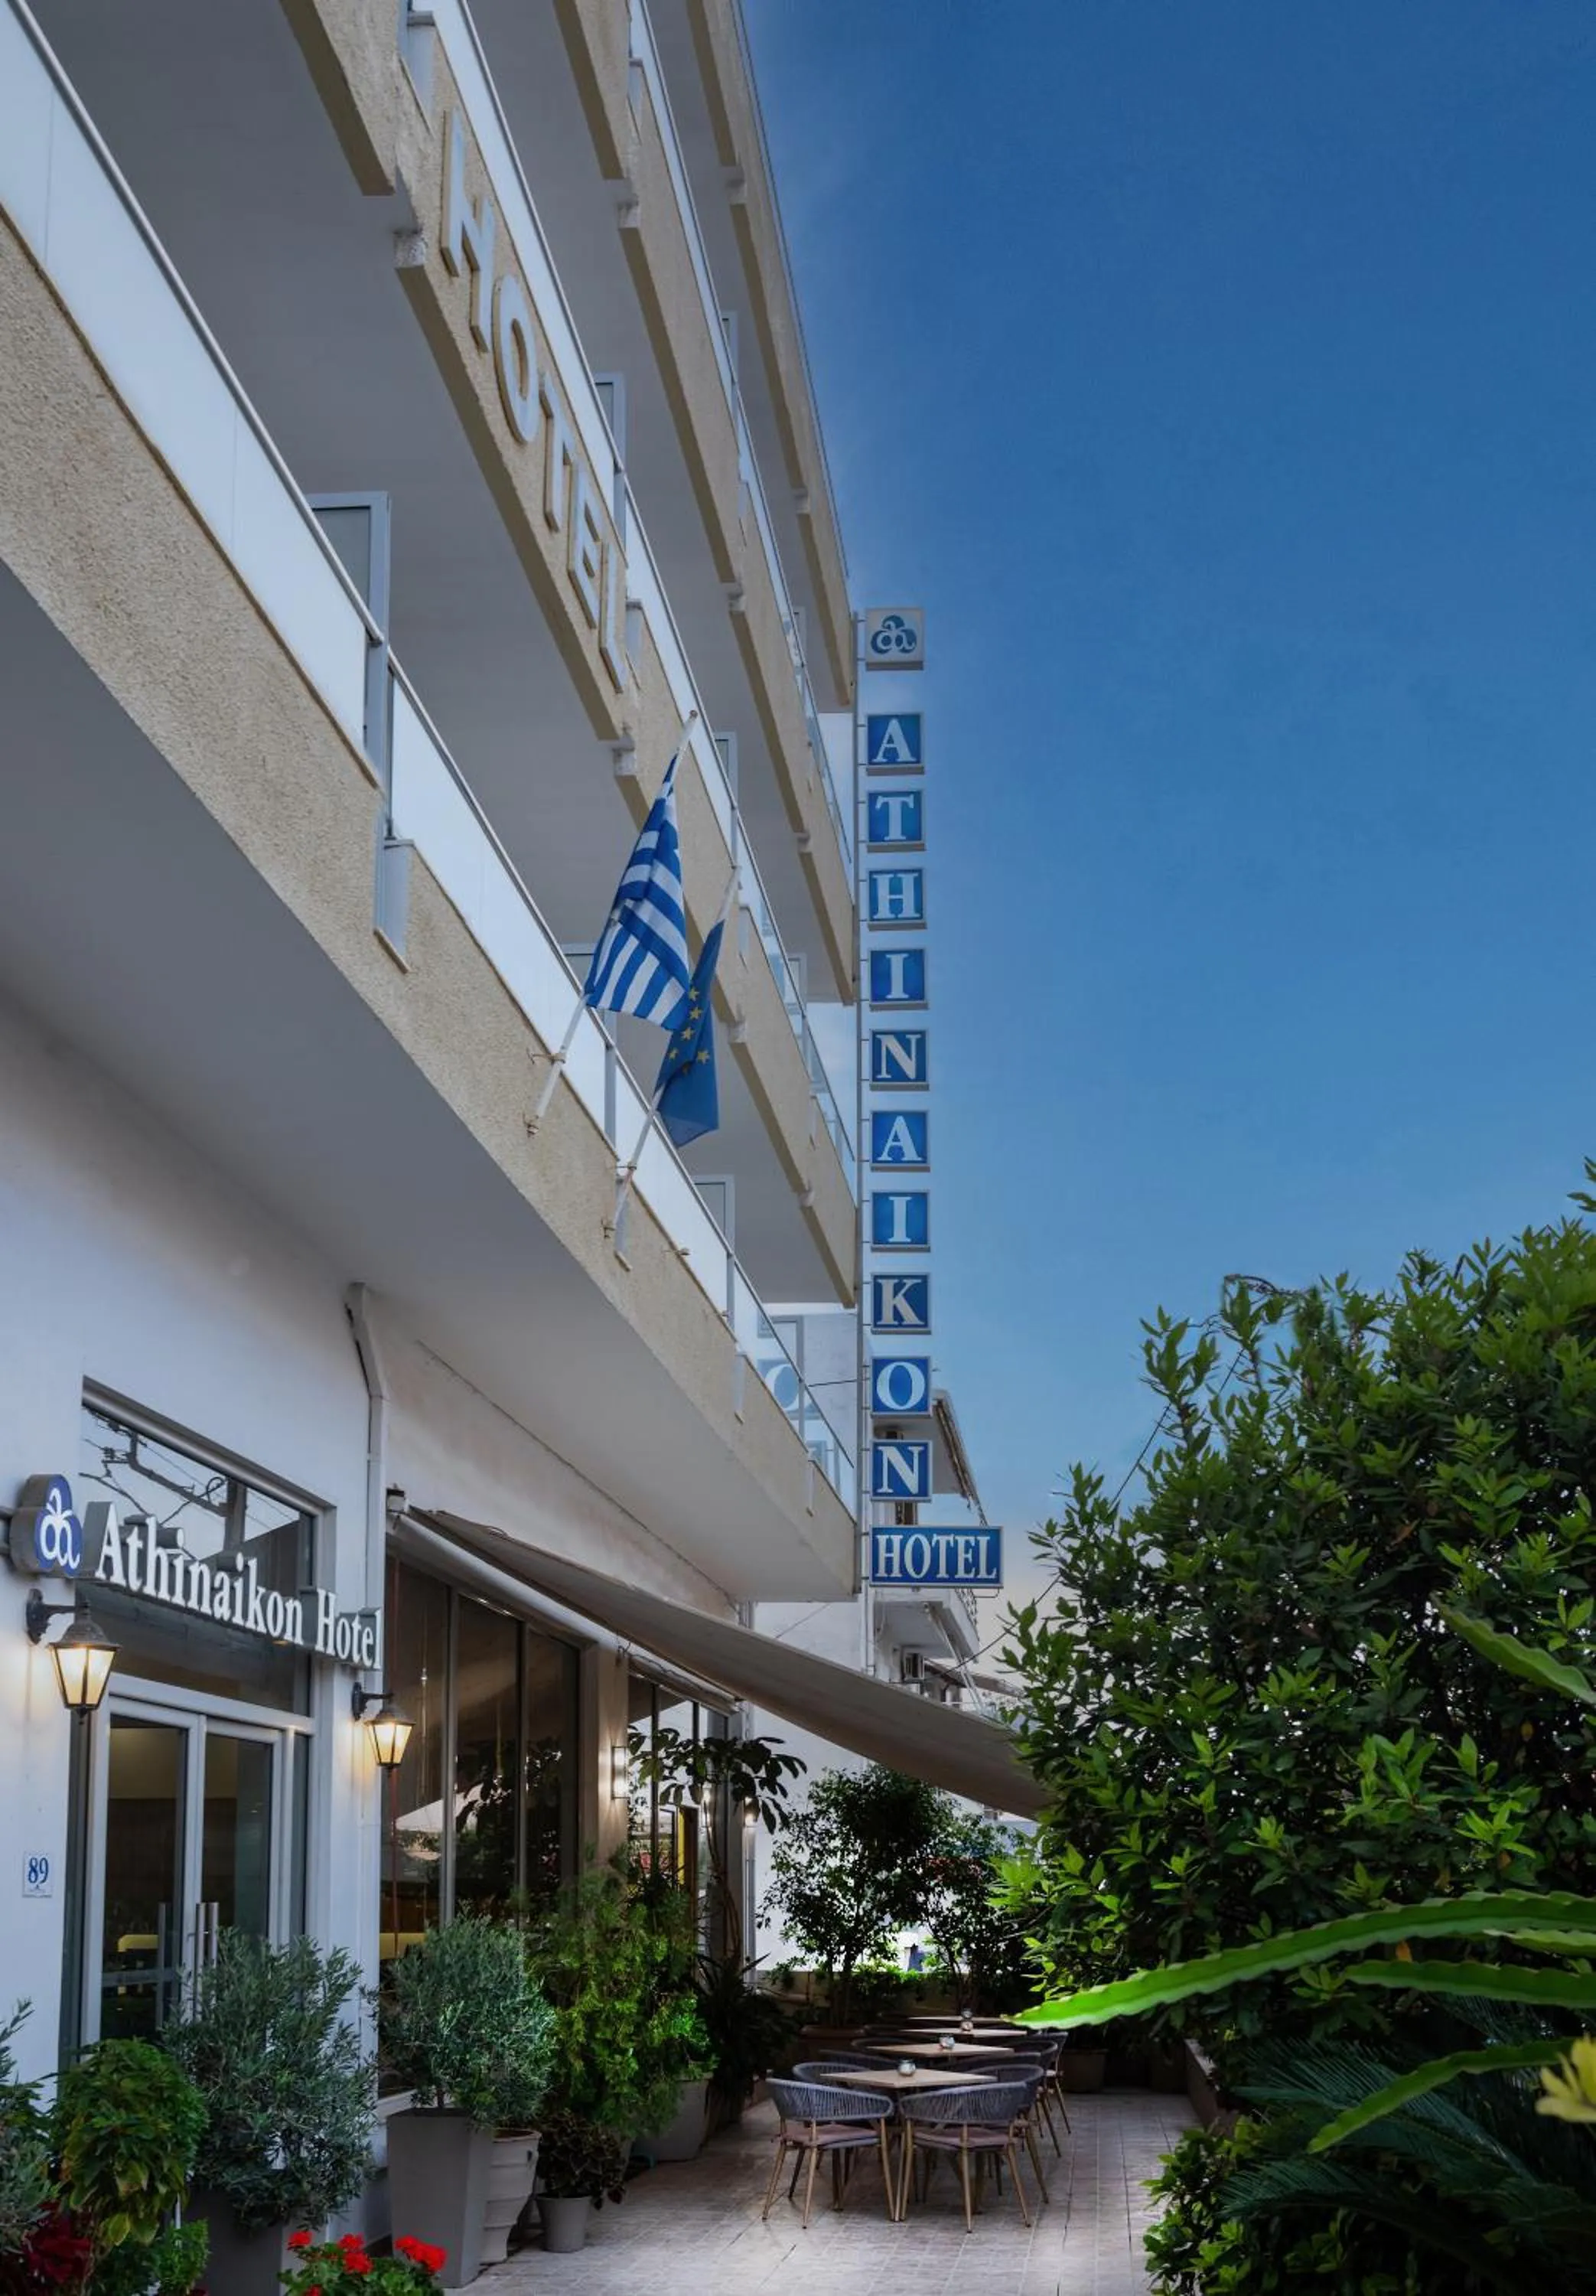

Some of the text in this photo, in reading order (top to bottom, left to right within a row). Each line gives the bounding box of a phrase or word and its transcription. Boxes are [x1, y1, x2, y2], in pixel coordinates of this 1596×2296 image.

[441, 106, 626, 693] HOTEL
[872, 718, 926, 1494] ATHINAIKON
[94, 1501, 305, 1646] Athinaikon
[314, 1588, 382, 1669] Hotel
[875, 1533, 997, 1580] HOTEL
[28, 1857, 49, 1884] 89
